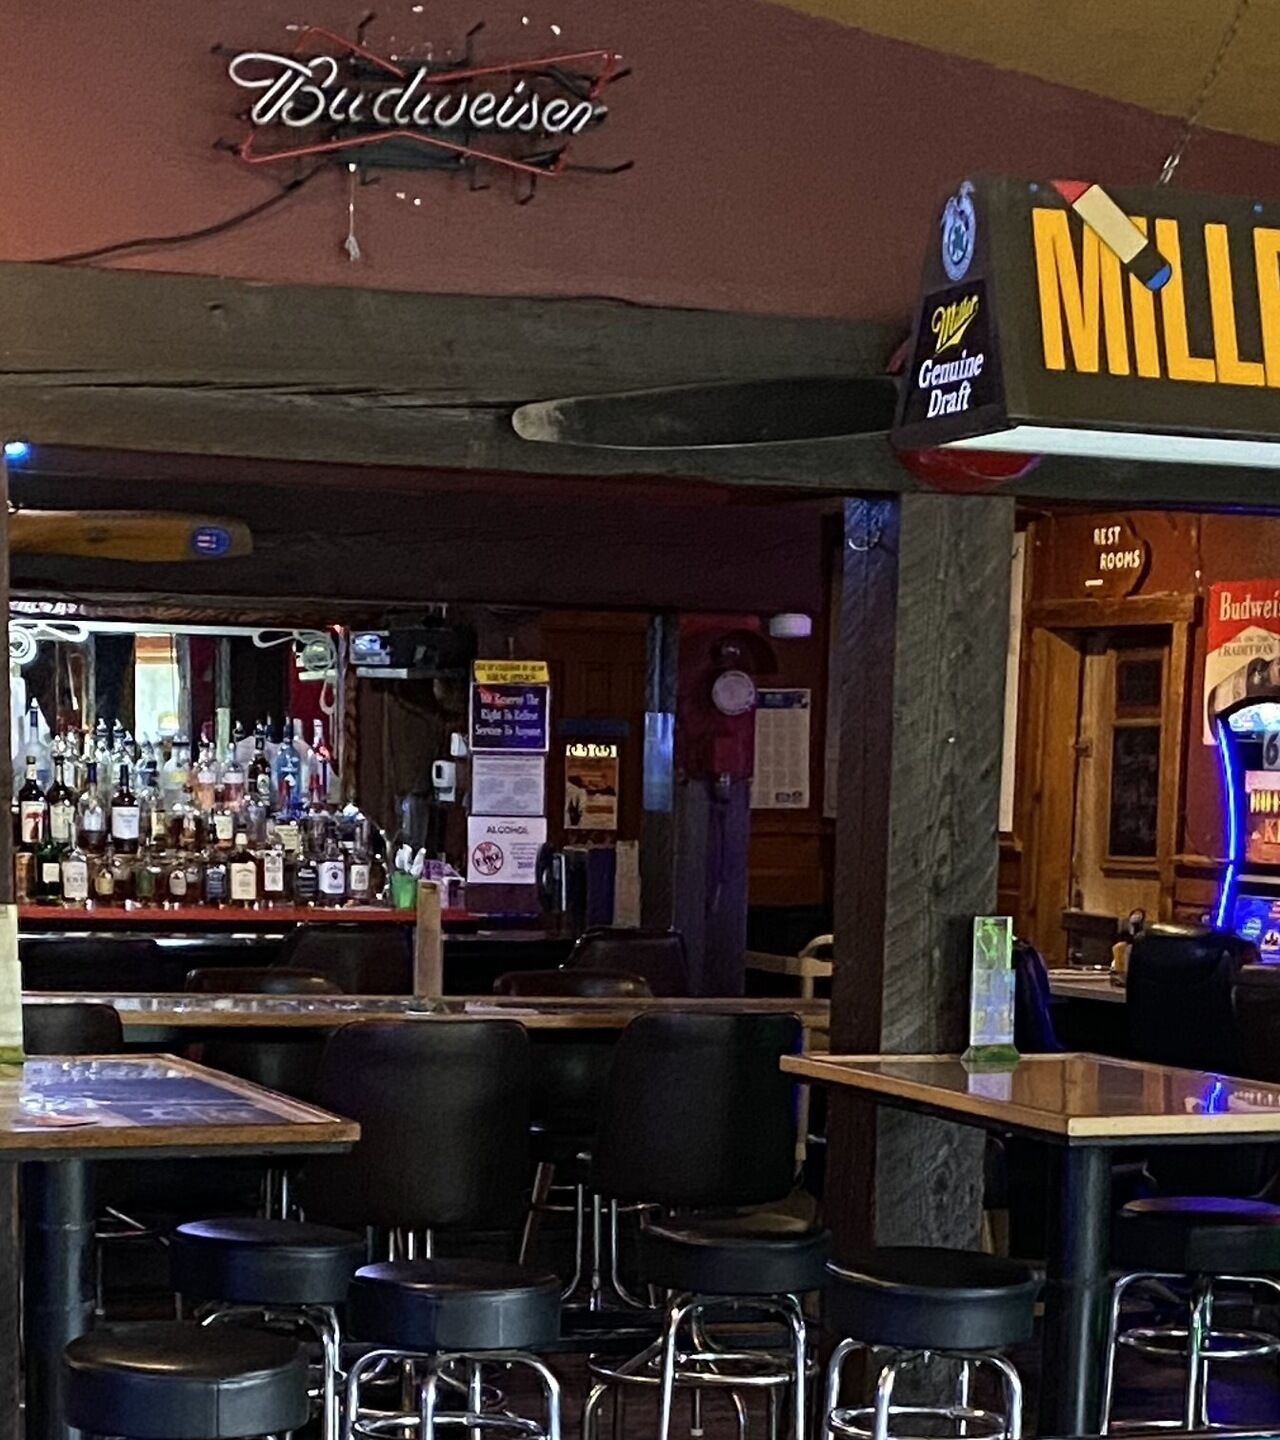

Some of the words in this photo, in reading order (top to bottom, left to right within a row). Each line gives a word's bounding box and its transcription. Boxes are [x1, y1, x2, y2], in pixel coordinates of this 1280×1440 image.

[229, 52, 604, 133] Budweiser
[931, 294, 979, 351] Miller
[919, 348, 984, 388] Genuine
[926, 380, 972, 418] Draft
[1094, 526, 1121, 545] REST
[1100, 549, 1140, 570] ROOMS
[480, 708, 502, 722] Right
[503, 709, 513, 720] To
[514, 709, 539, 720] Refuse
[475, 723, 503, 736] Service
[503, 724, 513, 736] To
[1265, 732, 1280, 766] 6
[486, 825, 529, 835] ALCOHOL
